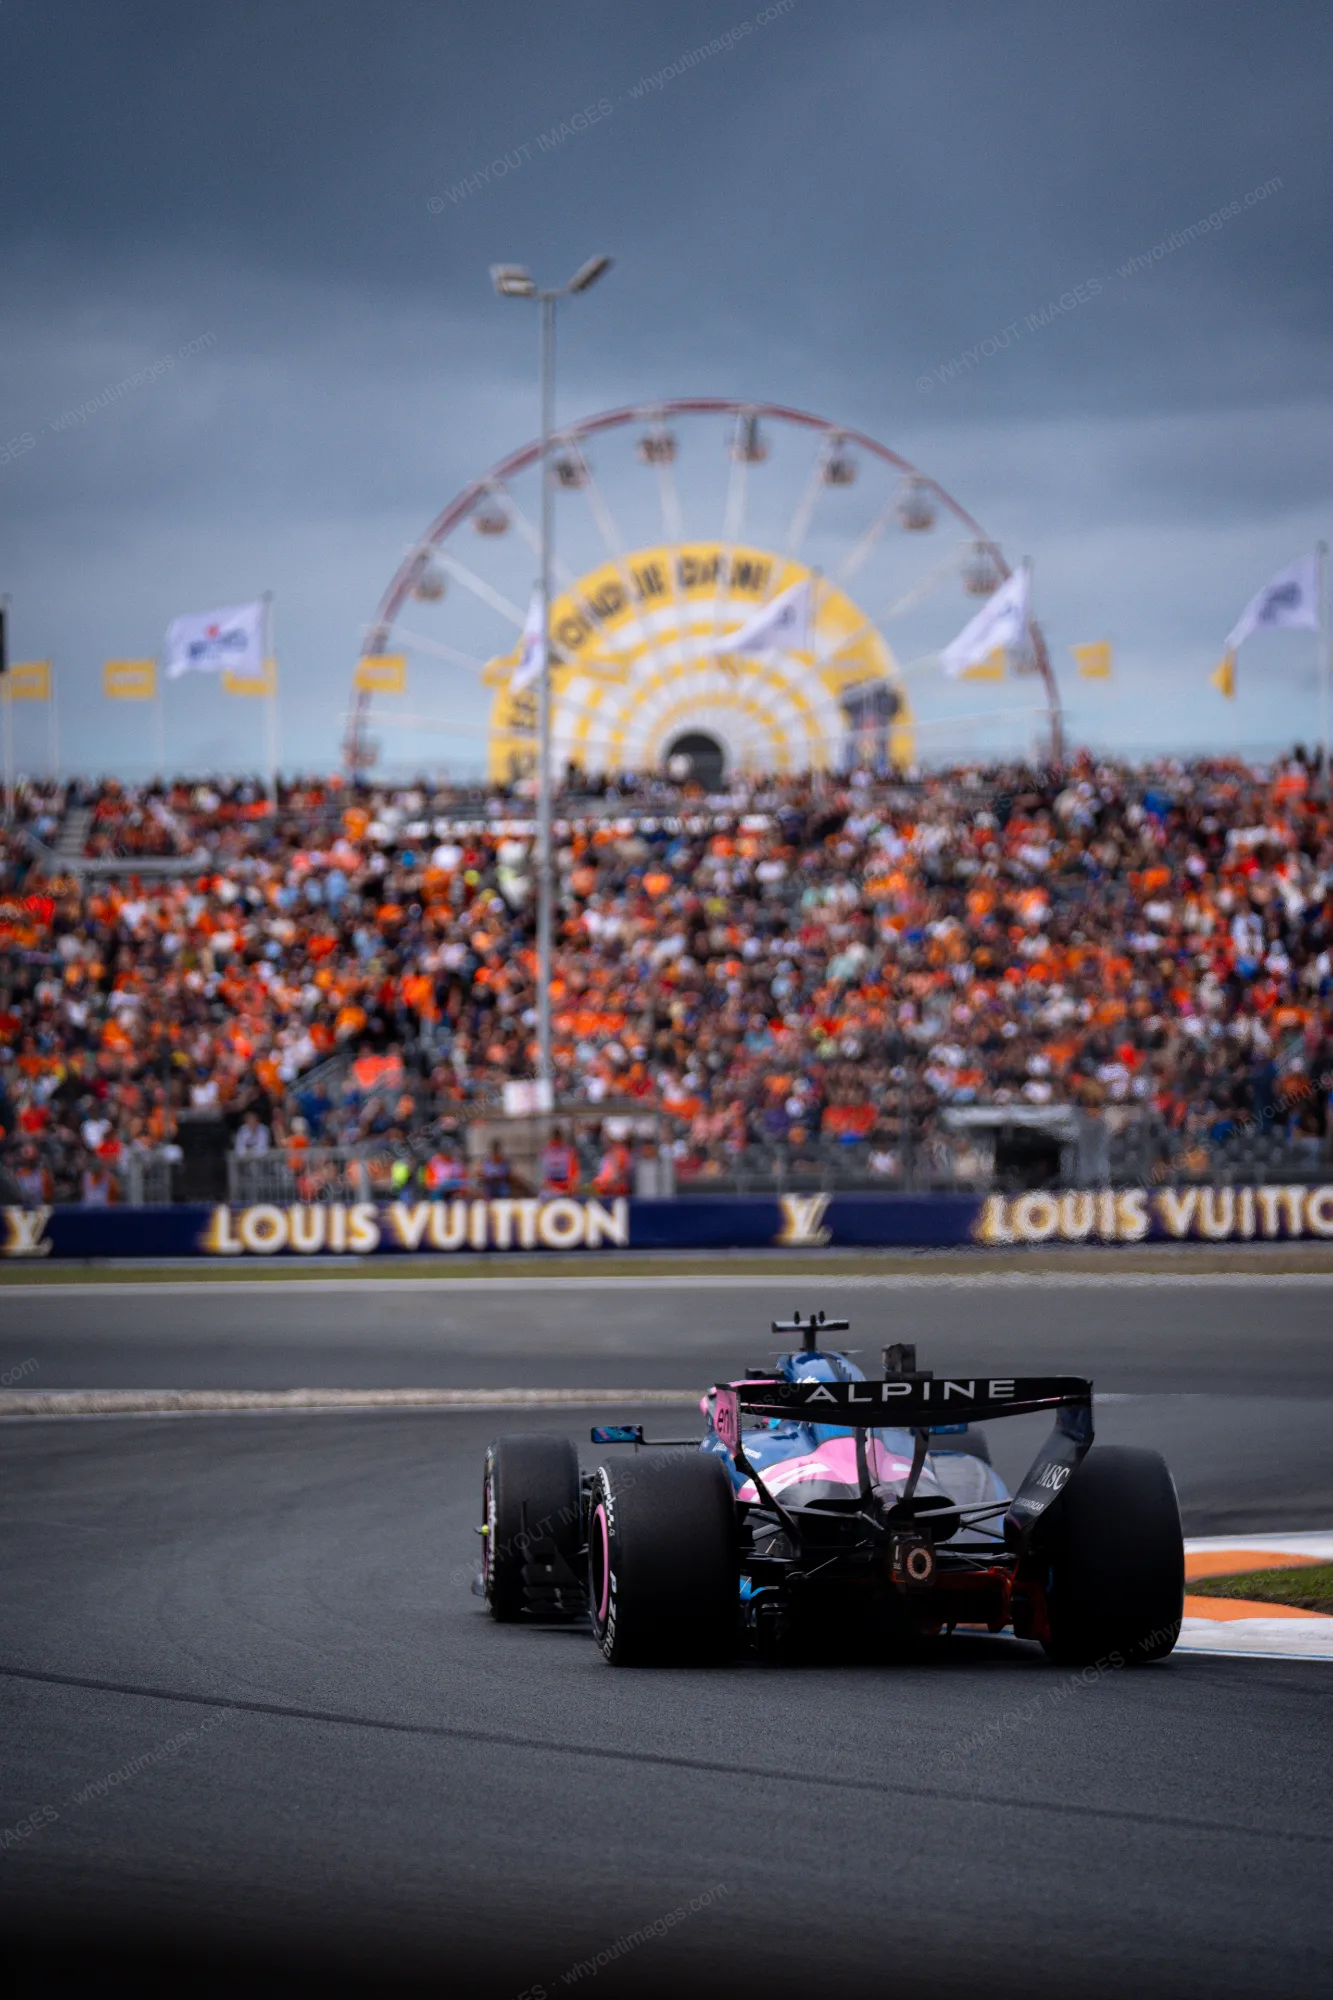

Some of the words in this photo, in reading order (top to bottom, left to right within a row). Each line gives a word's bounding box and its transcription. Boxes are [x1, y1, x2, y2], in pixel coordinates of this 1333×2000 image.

[206, 1200, 381, 1255] LOUIS
[388, 1197, 630, 1252] VUITTON
[978, 1189, 1150, 1245] LOUIS
[804, 1379, 1016, 1404] ALPINE
[1036, 1462, 1071, 1490] MSC
[603, 1596, 617, 1658] ZERO
